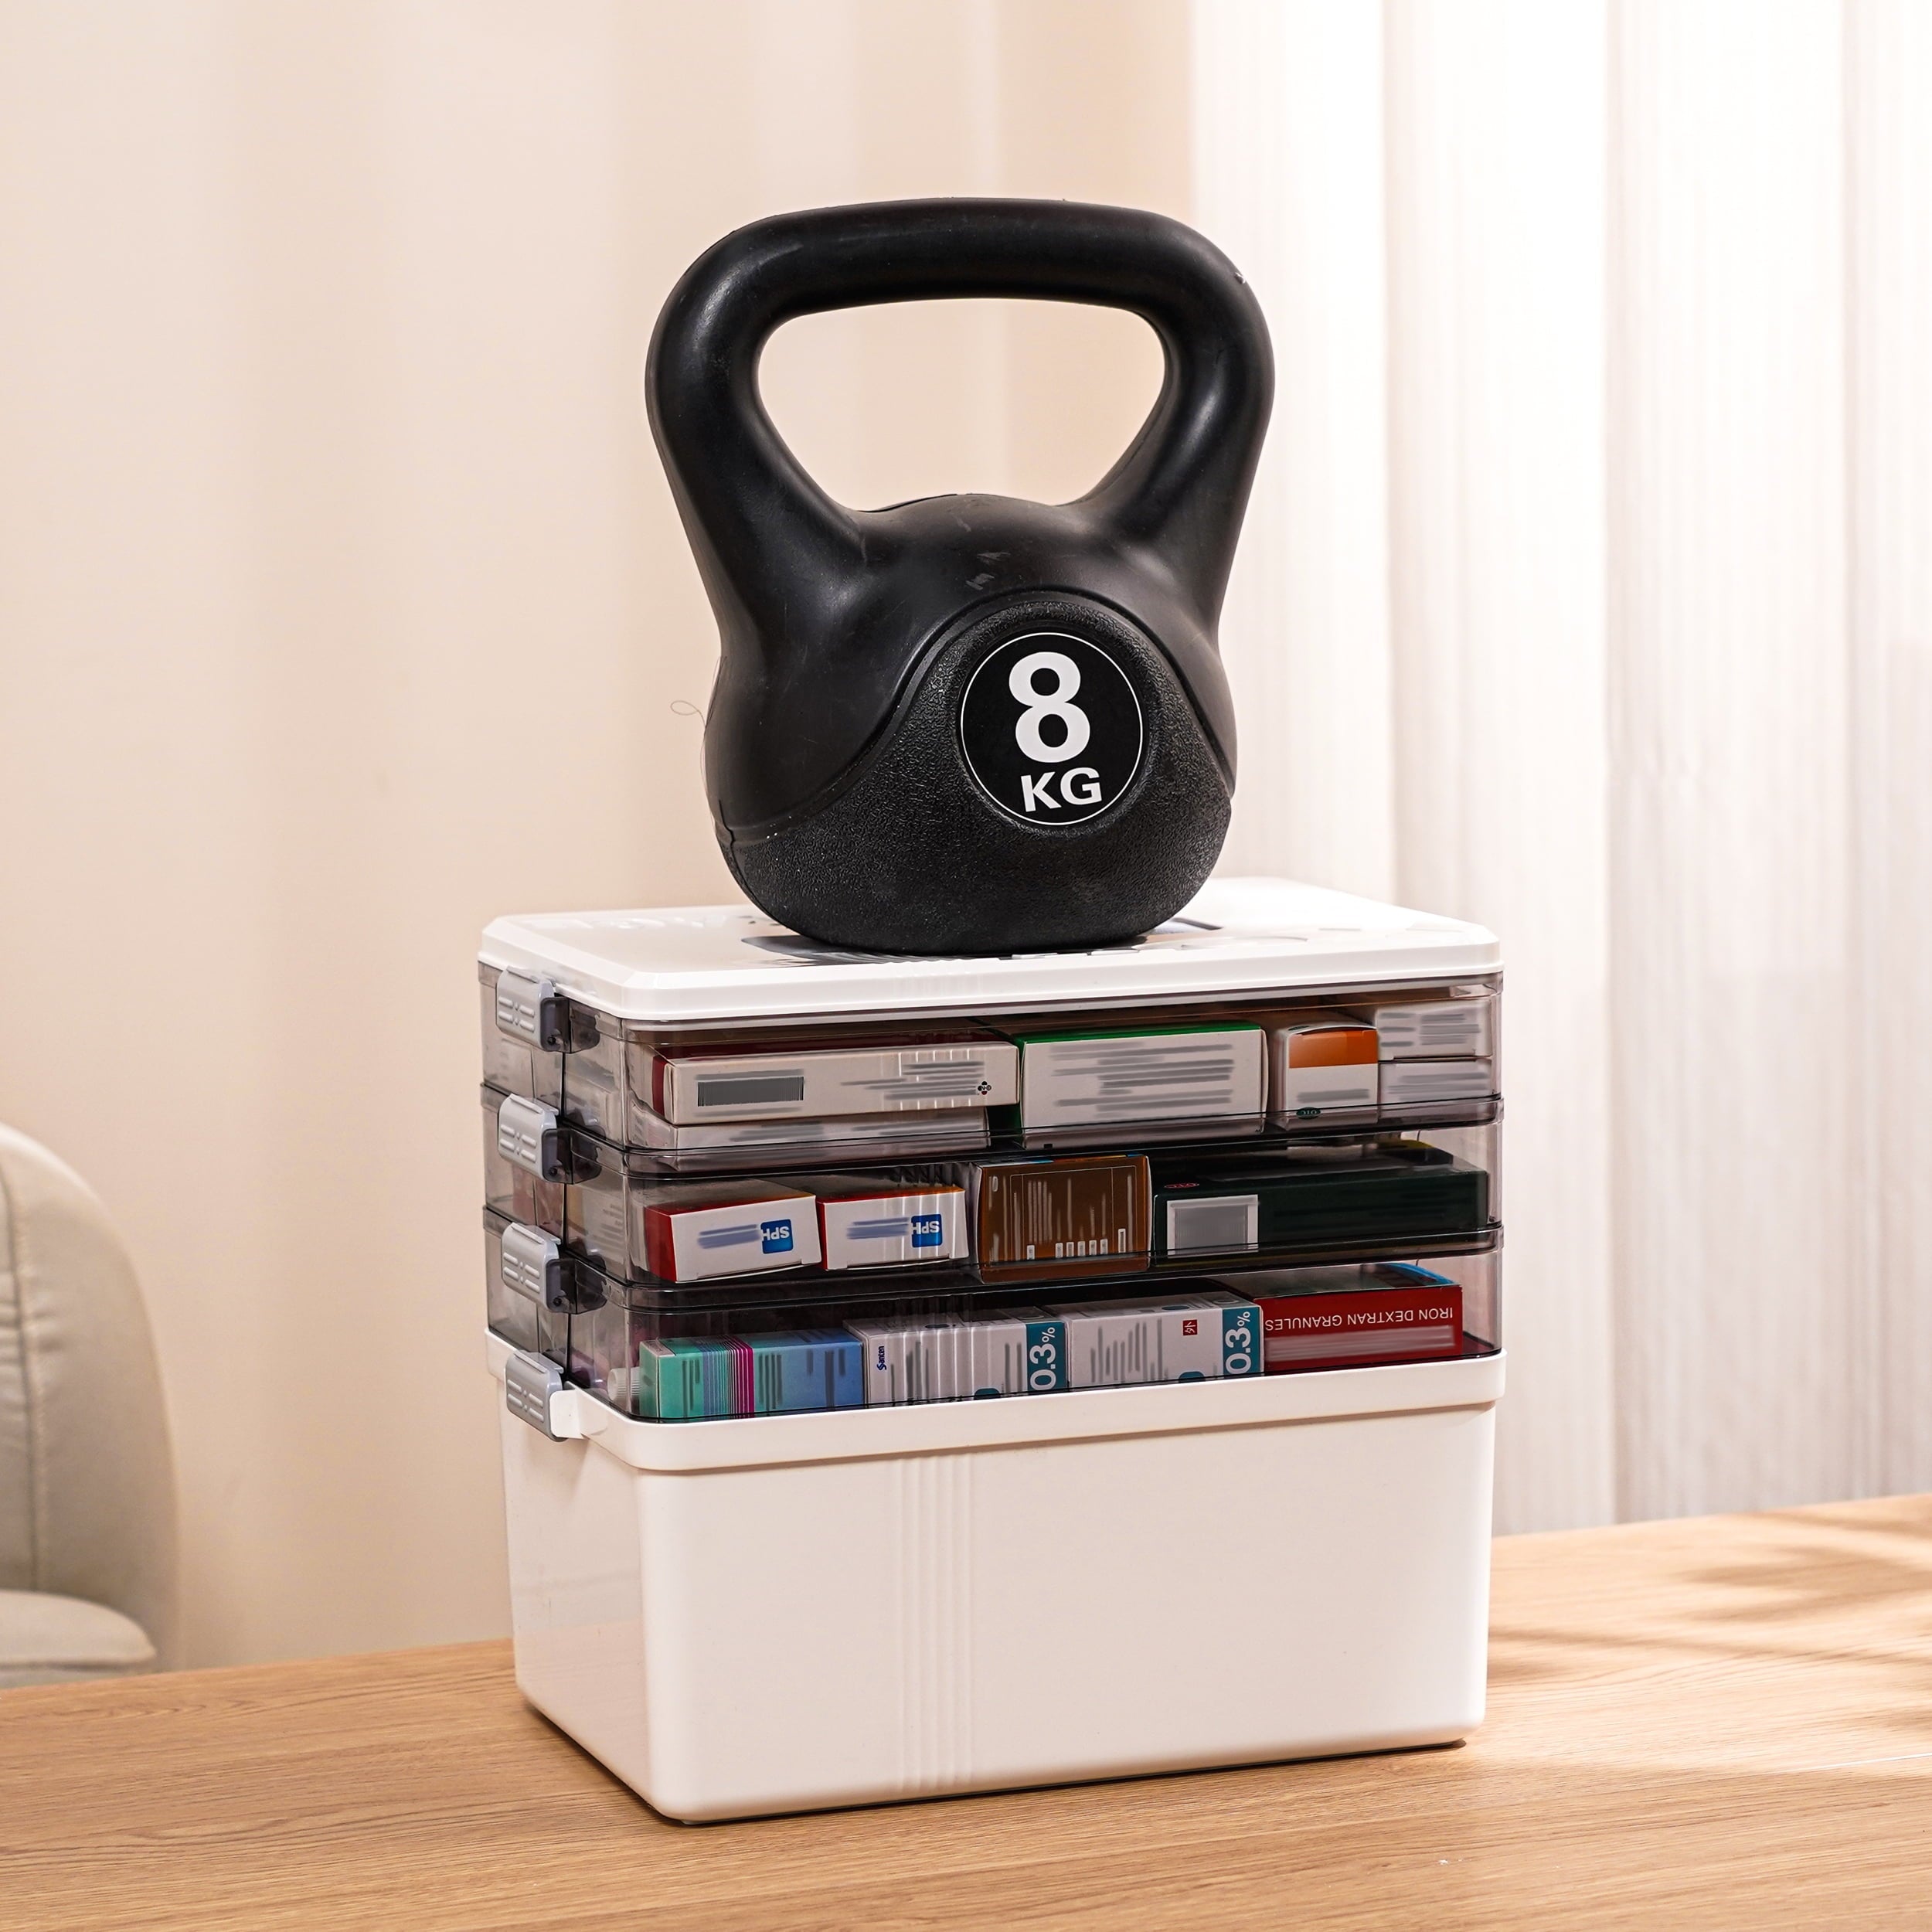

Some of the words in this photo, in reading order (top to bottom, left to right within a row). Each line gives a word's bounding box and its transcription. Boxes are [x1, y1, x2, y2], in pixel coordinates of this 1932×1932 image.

[1009, 651, 1090, 763] 8
[1021, 767, 1102, 812] KG
[760, 1226, 790, 1241] SPH
[911, 1220, 940, 1235] SPH
[1348, 1310, 1413, 1325] DEXTRAN
[1419, 1307, 1453, 1321] IRON
[1184, 1321, 1196, 1335] 外
[1265, 1315, 1342, 1331] GRANULES
[1225, 1311, 1251, 1374] 0.3%
[876, 1345, 887, 1371] Santen
[1029, 1327, 1056, 1391] 0.3%
